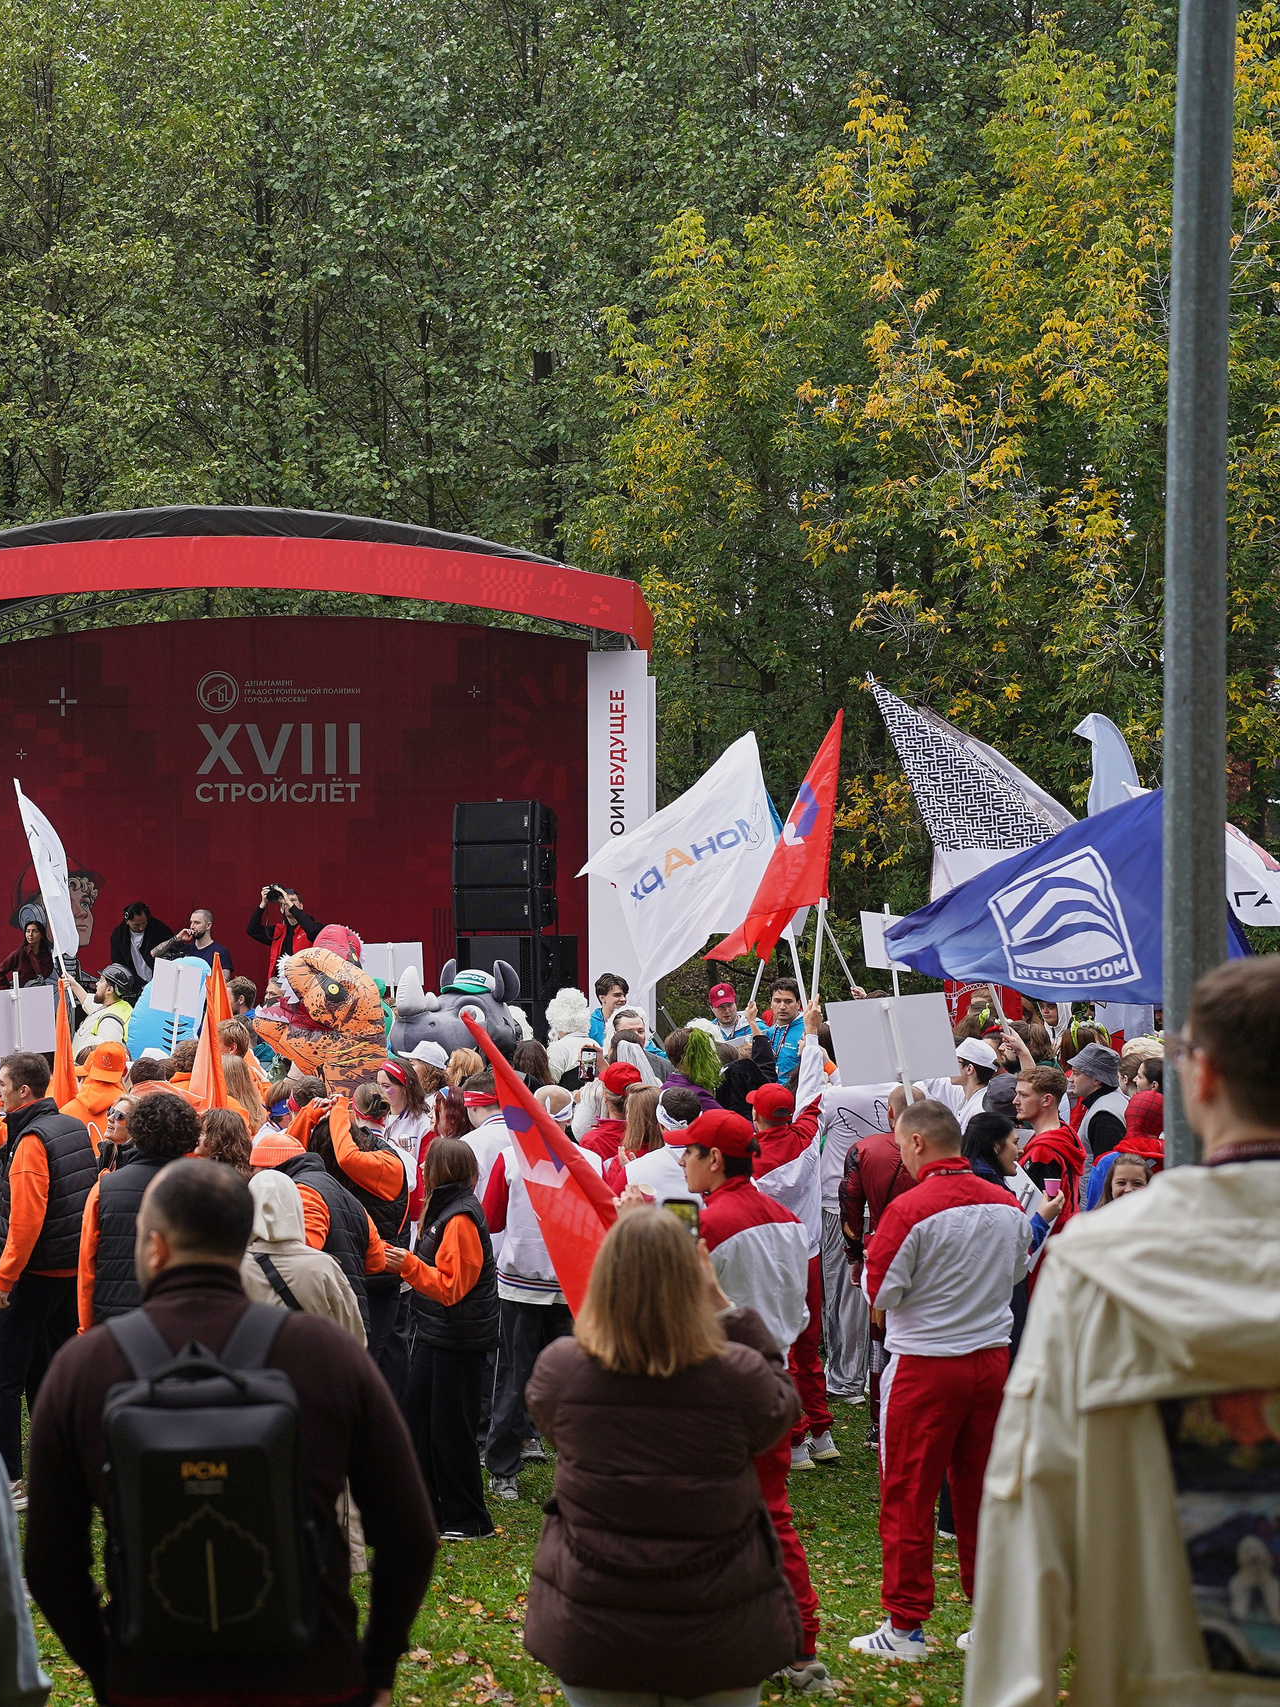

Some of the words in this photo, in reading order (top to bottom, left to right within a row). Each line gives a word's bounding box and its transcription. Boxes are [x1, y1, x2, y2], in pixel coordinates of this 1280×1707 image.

[245, 687, 321, 695] ГРАДОСТРОИТЕЛЬНОЙ
[196, 723, 361, 775] XVIII
[609, 690, 627, 836] ОИМБУДУЩЕЕ
[195, 777, 361, 803] СТРОЙСЛЁТ
